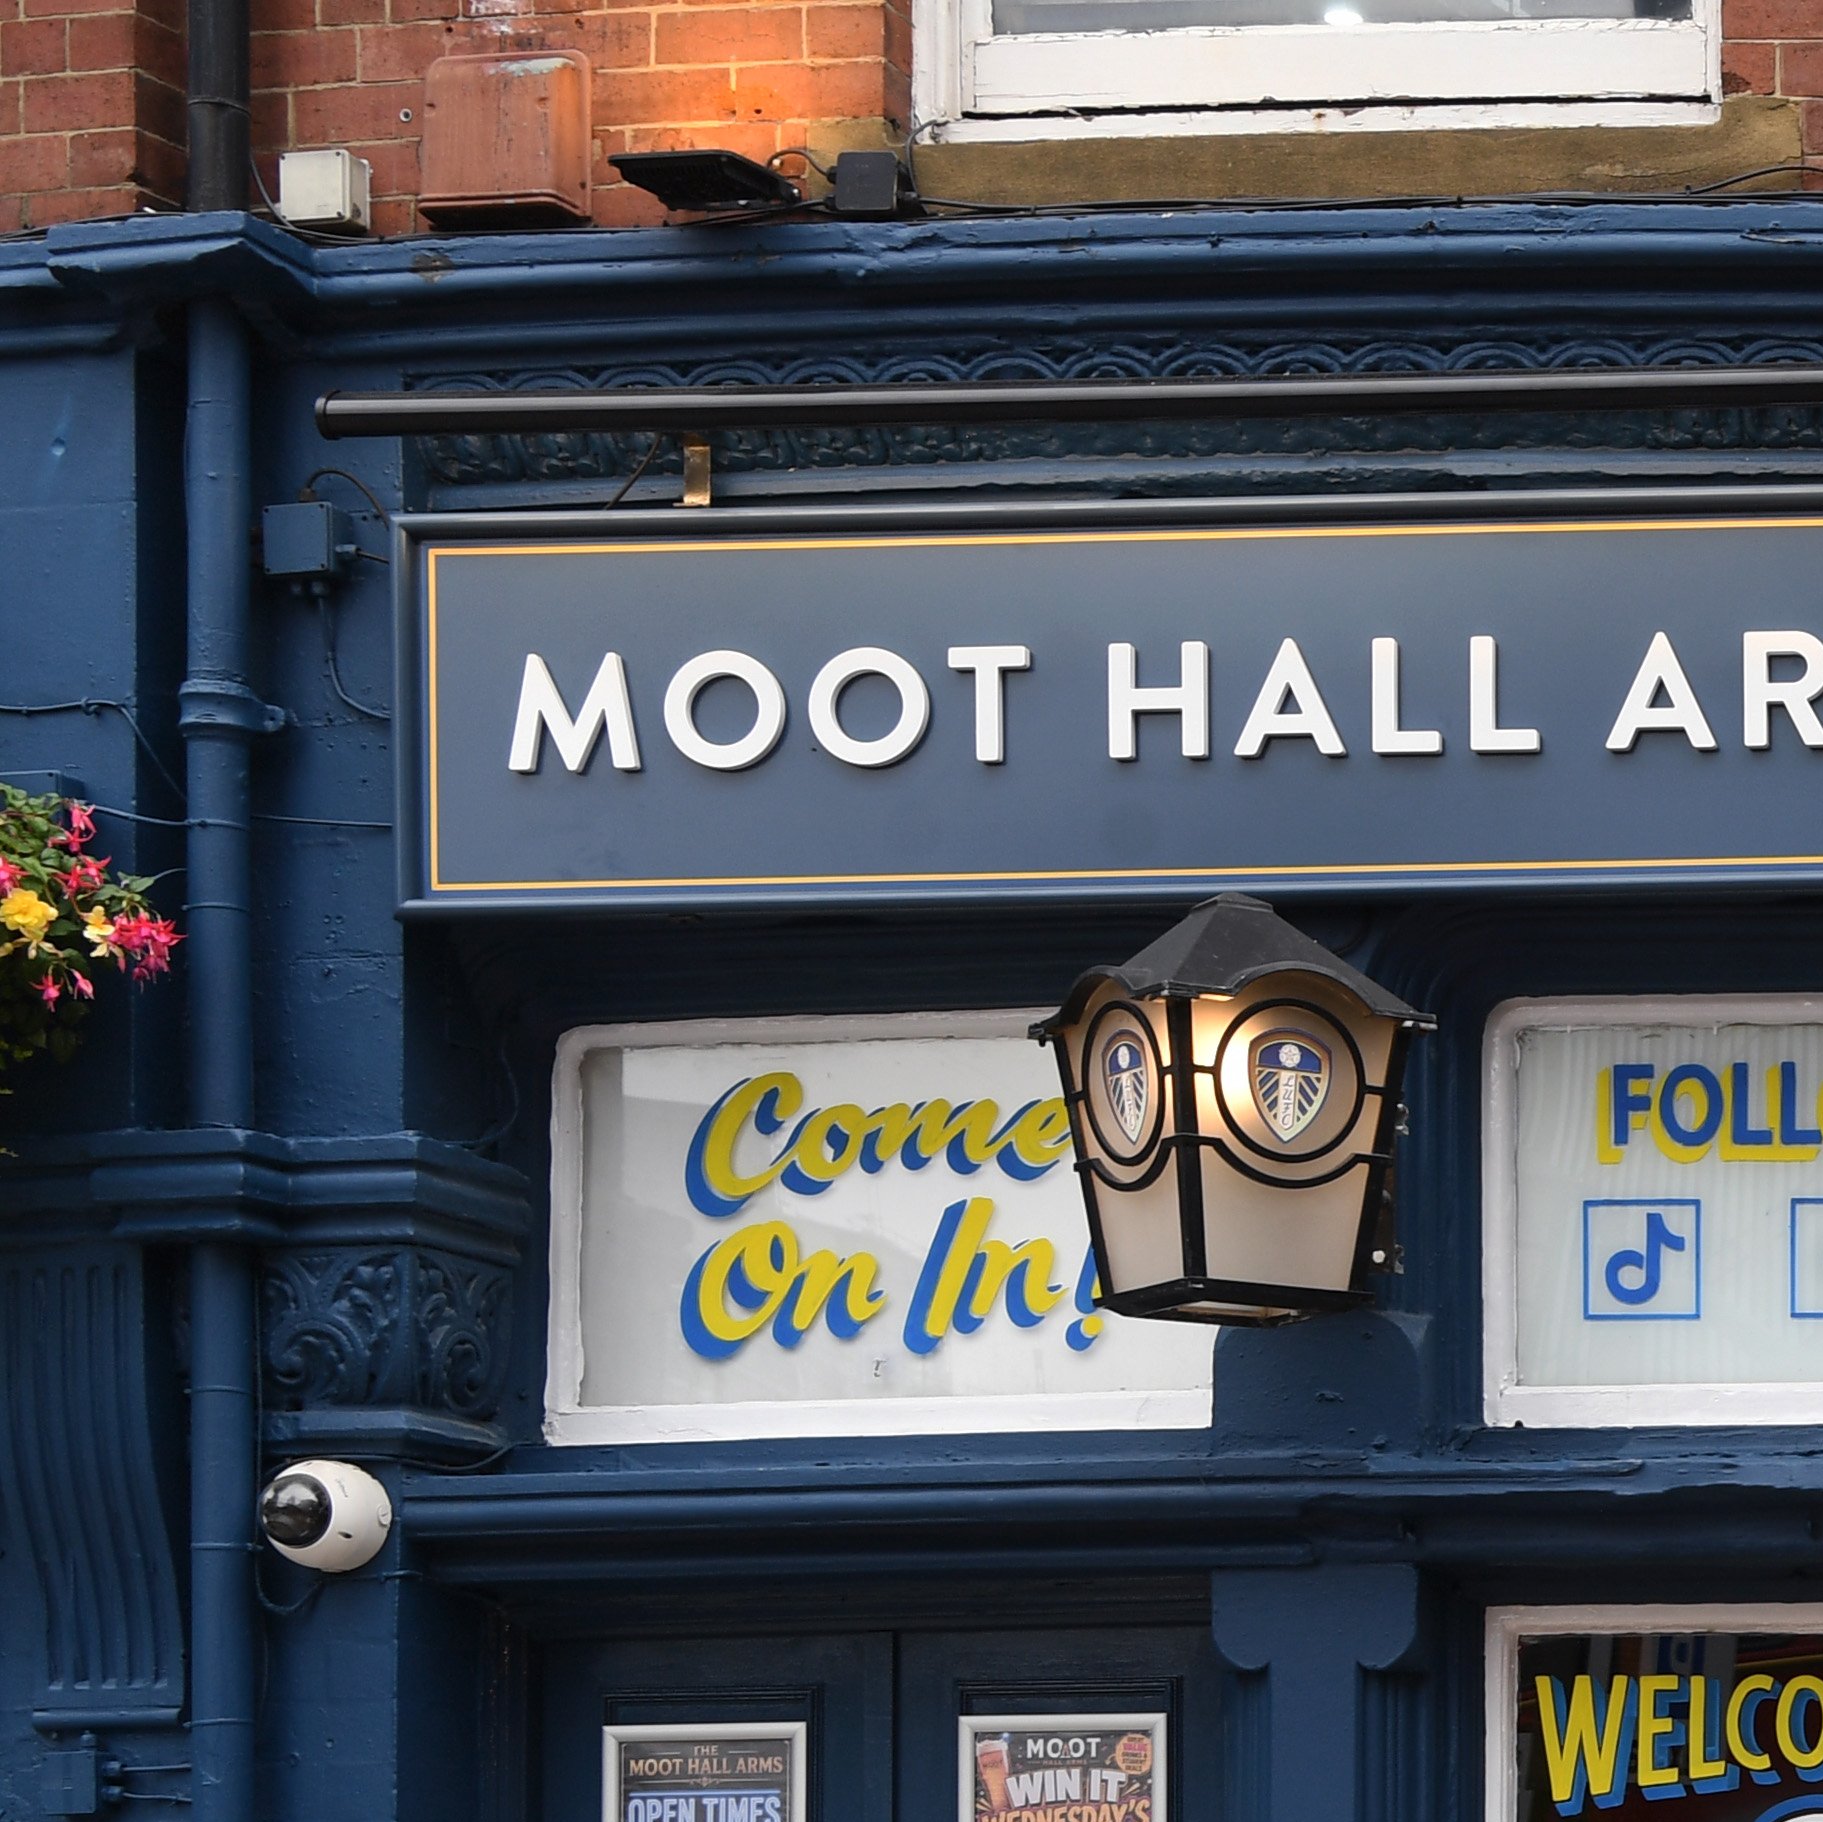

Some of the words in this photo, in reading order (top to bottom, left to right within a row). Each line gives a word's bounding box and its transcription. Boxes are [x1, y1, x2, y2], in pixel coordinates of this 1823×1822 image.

[508, 646, 1032, 774] MOOT
[1107, 633, 1541, 761] HALL
[685, 1072, 1070, 1217] Come
[680, 1220, 887, 1359] On
[629, 1758, 684, 1776] MOOT
[688, 1758, 731, 1774] HALL
[735, 1757, 783, 1774] ARMS
[694, 1745, 719, 1755] THE
[1027, 1738, 1101, 1759] MOOT
[1006, 1768, 1081, 1807] WIN
[1089, 1769, 1127, 1803] IT
